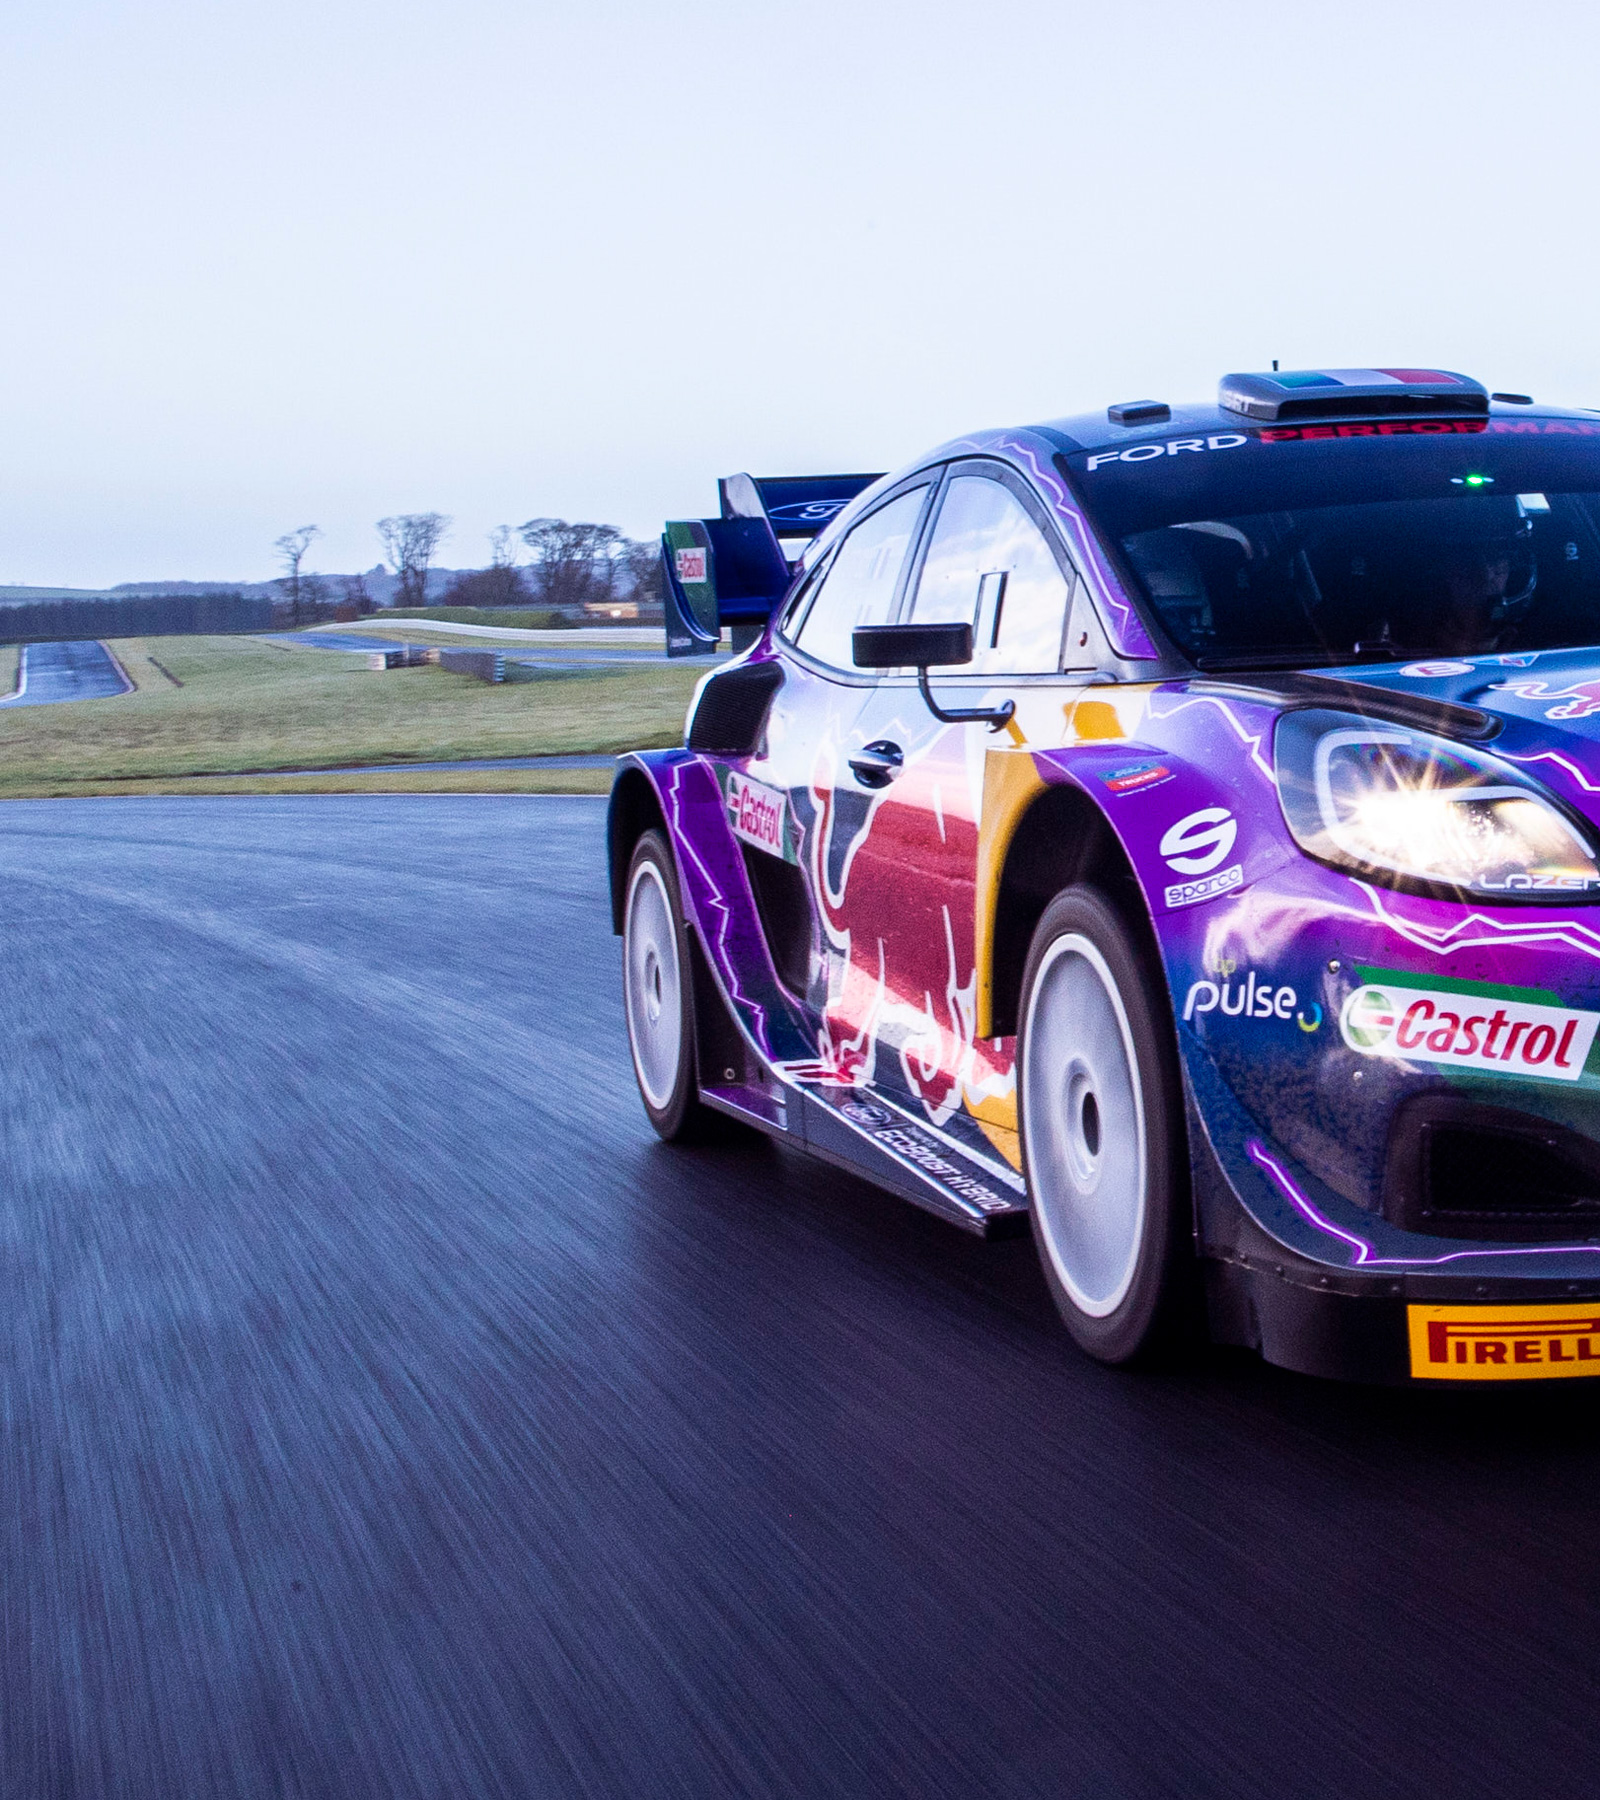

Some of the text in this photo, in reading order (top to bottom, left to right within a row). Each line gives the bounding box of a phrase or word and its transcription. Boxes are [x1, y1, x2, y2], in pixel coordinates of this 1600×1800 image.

[1087, 434, 1248, 471] FORD
[740, 784, 782, 848] Castrol
[1168, 868, 1240, 902] sparco
[1183, 970, 1297, 1021] pulse
[1395, 998, 1579, 1069] Castrol
